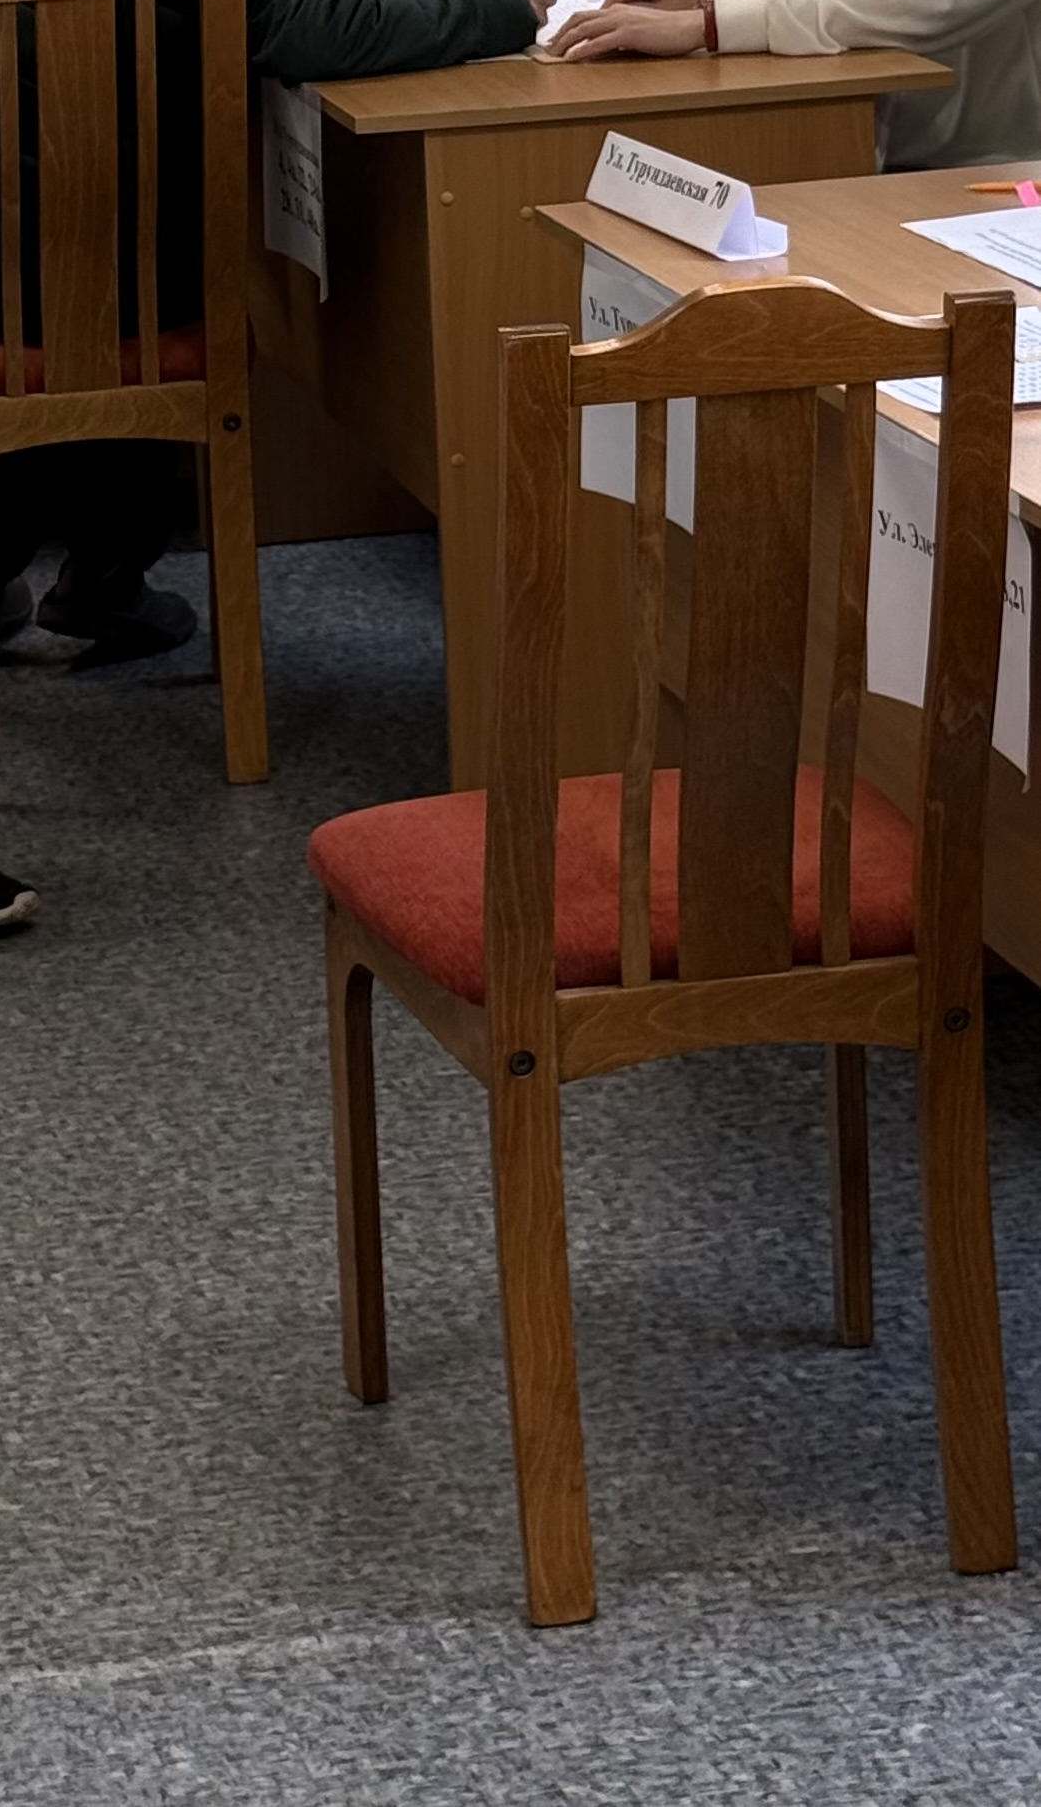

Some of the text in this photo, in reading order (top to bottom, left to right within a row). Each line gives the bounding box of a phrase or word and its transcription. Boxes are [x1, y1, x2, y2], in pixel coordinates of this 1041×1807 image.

[605, 143, 731, 210] Ул. Турундаевская 70
[588, 295, 610, 327] Ул.
[877, 509, 906, 543] Ул.
